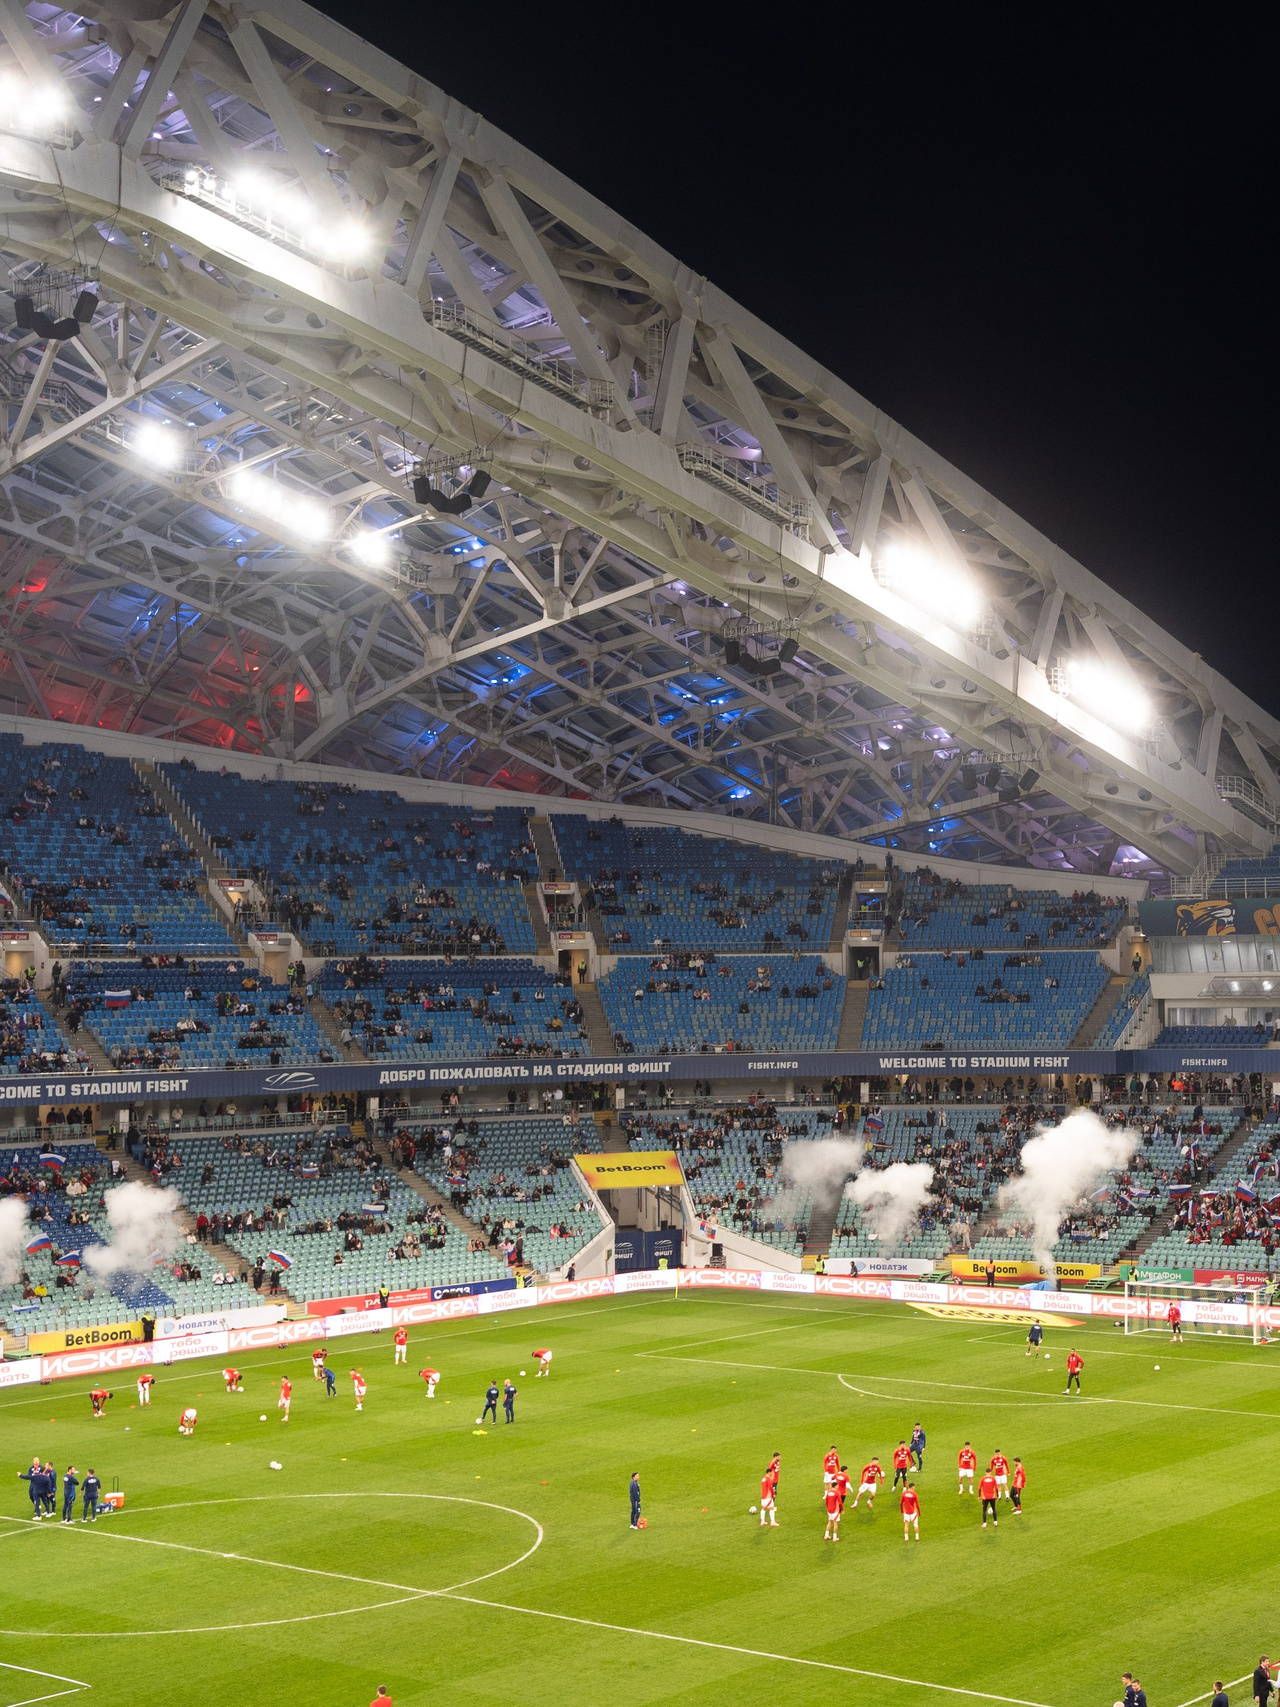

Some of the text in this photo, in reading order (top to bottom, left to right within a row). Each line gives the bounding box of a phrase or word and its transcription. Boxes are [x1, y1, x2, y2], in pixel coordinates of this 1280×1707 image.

[748, 1061, 798, 1070] FISHT.INFO
[879, 1056, 1070, 1069] WELCOME TO STADIUM FISHT
[1181, 1058, 1228, 1066] FISHT.INFO
[380, 1061, 672, 1084] ДОБРО ПОЖАЛОВАТЬ НА СТАДИОН ФИШТ
[48, 1084, 66, 1097] TO
[71, 1080, 142, 1096] STADIUM
[146, 1079, 188, 1093] FISHT
[595, 1164, 666, 1173] BetBoom
[869, 1263, 908, 1271] НОВАТЭК
[972, 1264, 1018, 1274] Beoom
[679, 1270, 761, 1286] ИСКРА
[816, 1277, 891, 1296] ИСКРА
[538, 1278, 614, 1302] ИСКРА
[950, 1286, 1030, 1307] ИСКРА
[394, 1300, 478, 1324] ИСКРА
[178, 1319, 218, 1330] НОВАТЭК
[66, 1328, 132, 1347] BetBoom
[230, 1319, 325, 1349] ИСКРА
[43, 1344, 153, 1377] ИСКРА
